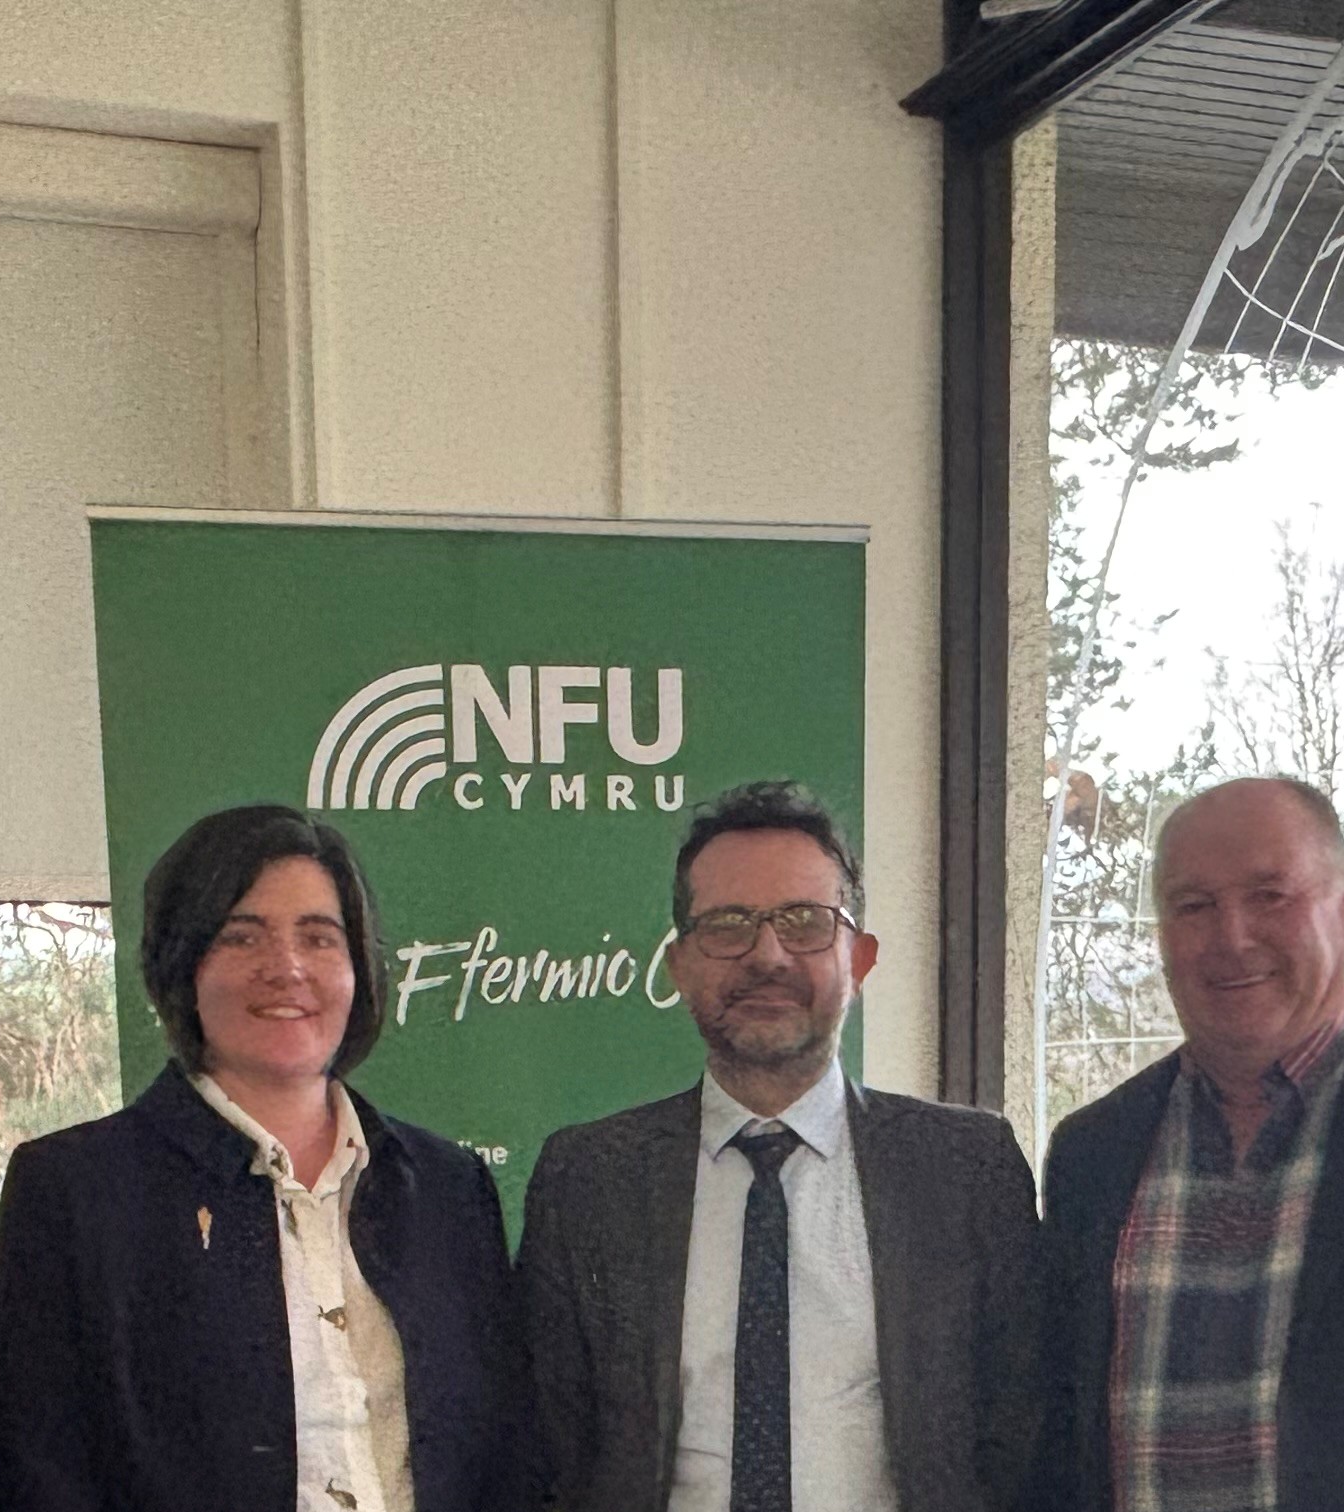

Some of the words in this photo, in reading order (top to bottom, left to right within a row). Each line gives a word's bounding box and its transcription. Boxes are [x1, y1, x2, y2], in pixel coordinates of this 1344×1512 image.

[450, 663, 684, 766] NFU
[453, 772, 685, 812] CYMRU
[395, 925, 639, 1027] Ffermio
